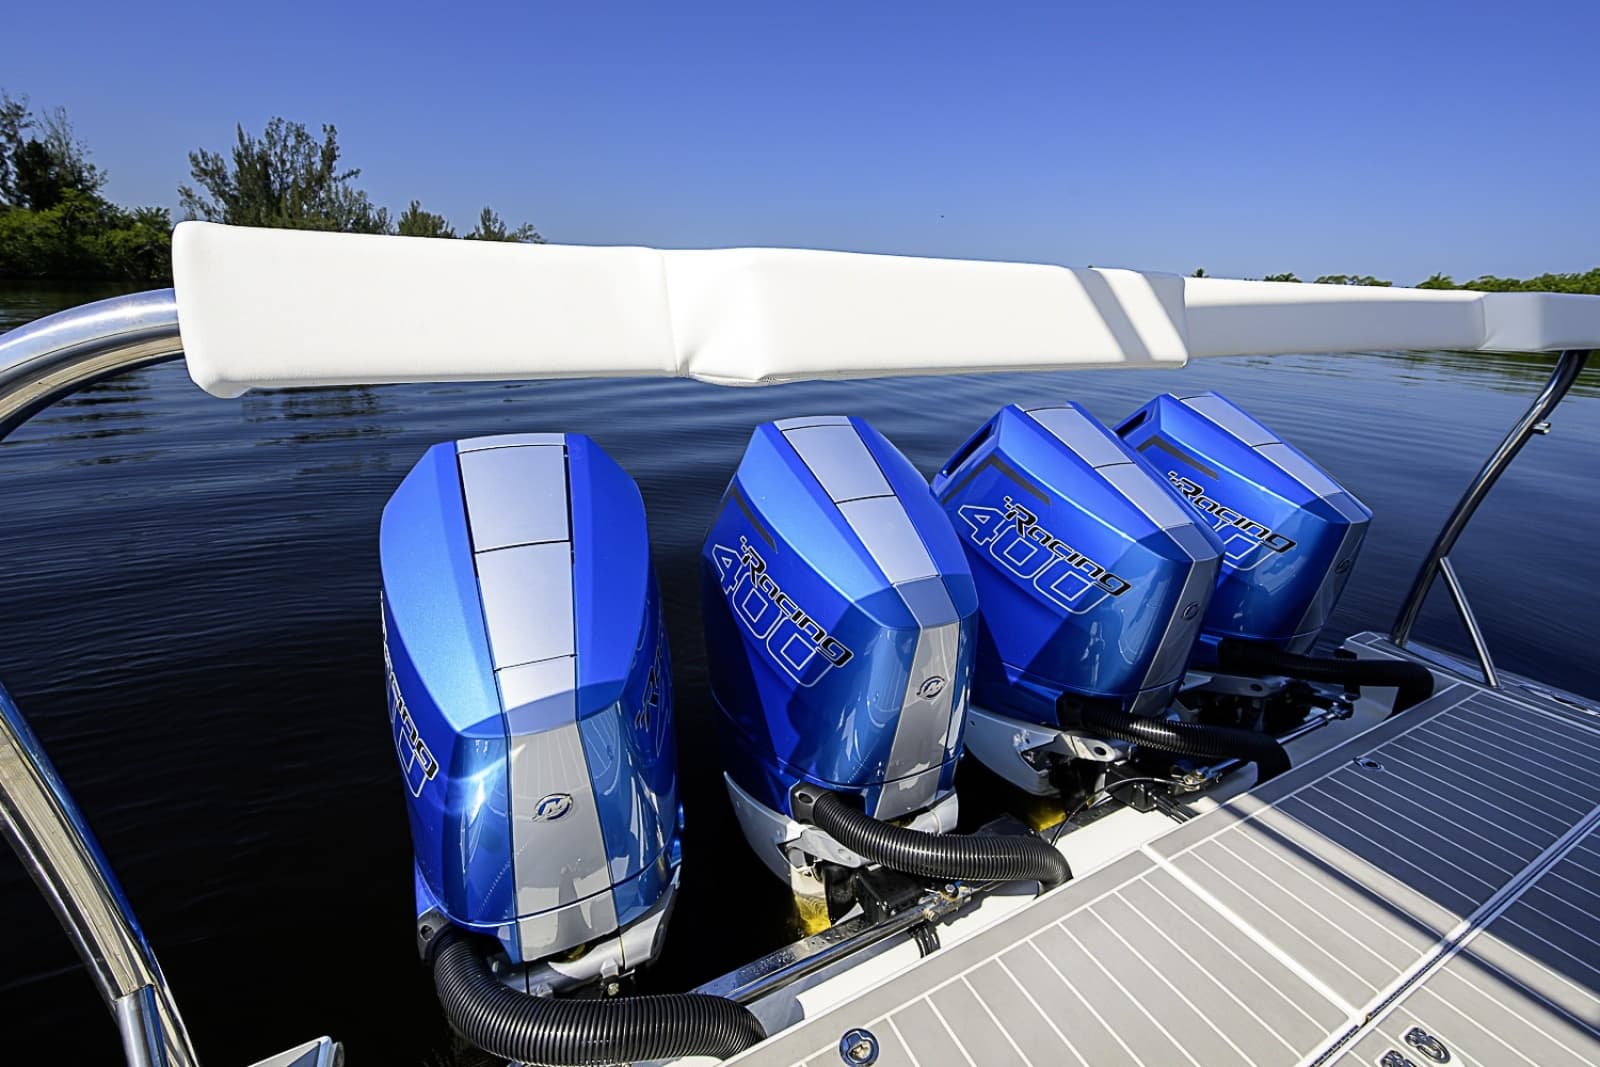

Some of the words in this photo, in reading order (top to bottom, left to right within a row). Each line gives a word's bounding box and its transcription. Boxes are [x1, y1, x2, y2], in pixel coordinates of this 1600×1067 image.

[958, 504, 1111, 615] 400
[1004, 497, 1132, 597] Racing
[1169, 472, 1297, 554] Racing
[711, 543, 834, 688] 400
[740, 537, 854, 668] Racing
